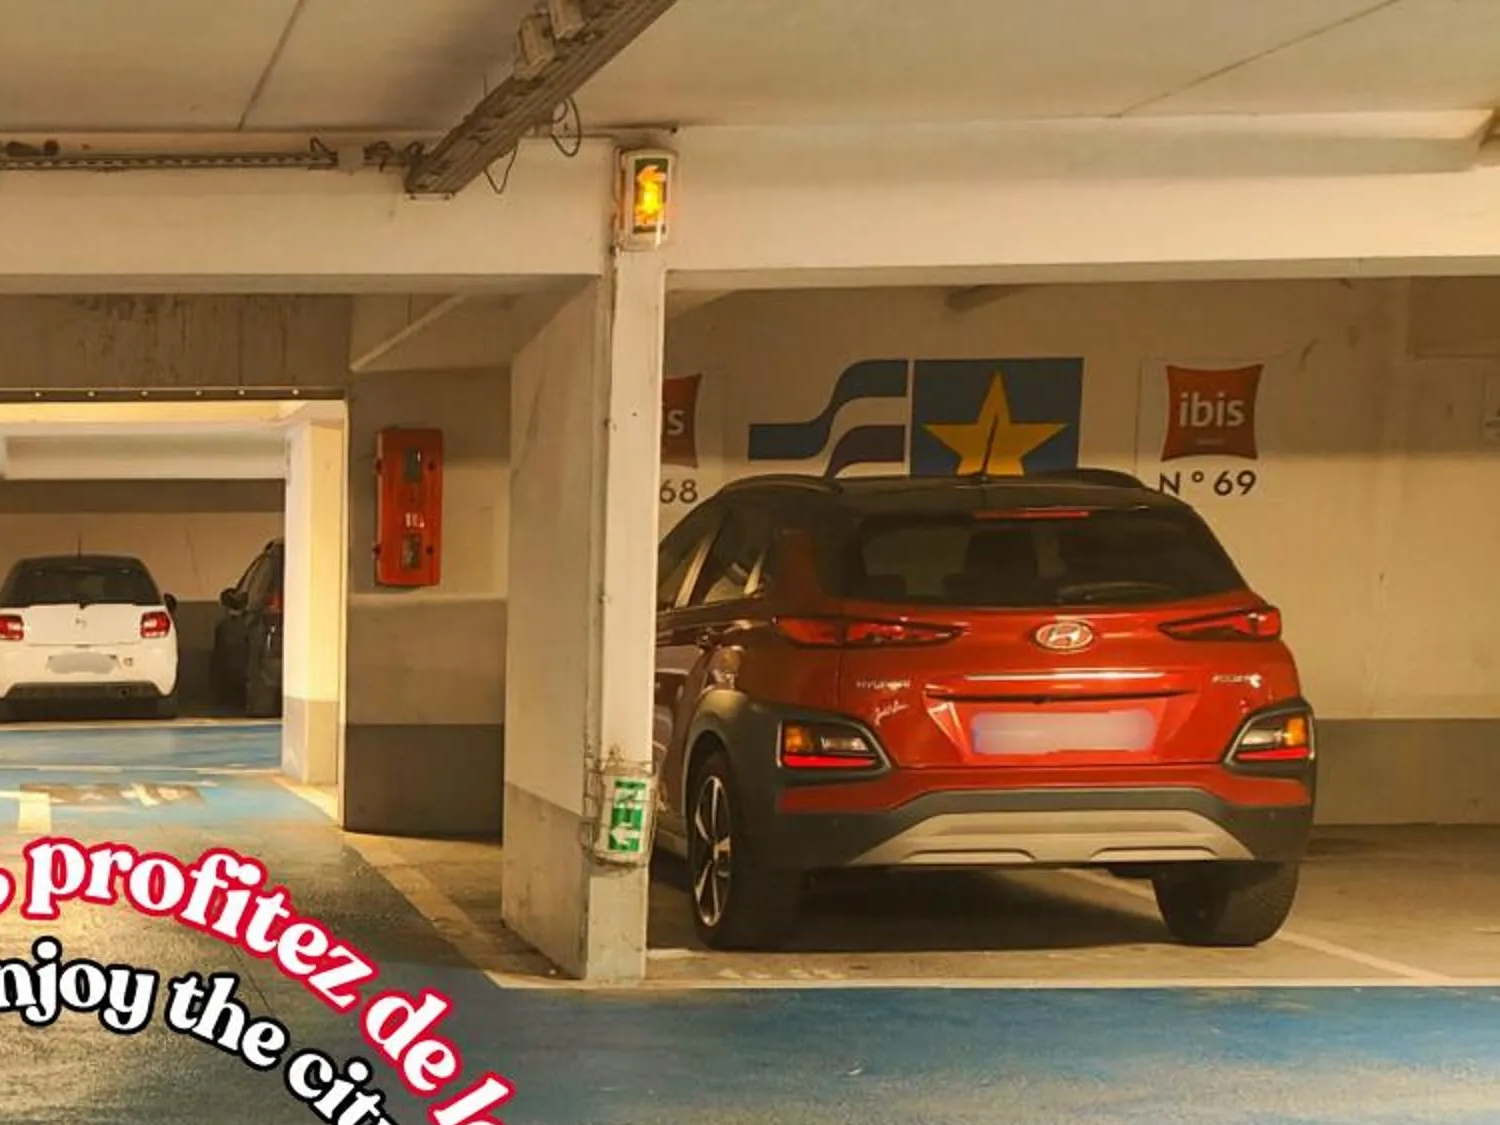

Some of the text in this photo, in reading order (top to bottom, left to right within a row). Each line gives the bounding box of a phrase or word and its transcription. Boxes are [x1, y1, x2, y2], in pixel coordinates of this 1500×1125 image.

[1180, 391, 1245, 427] ibis
[660, 478, 698, 504] 68
[1213, 469, 1257, 497] 69
